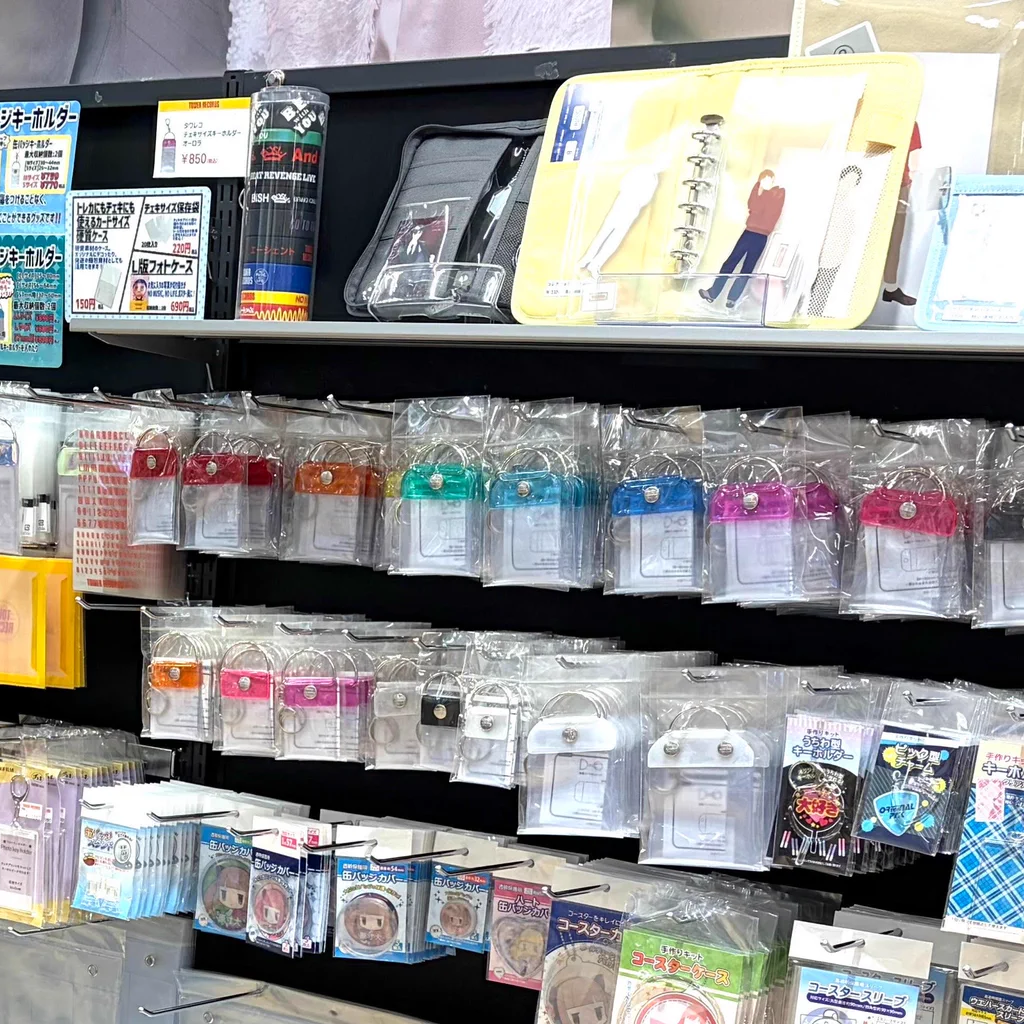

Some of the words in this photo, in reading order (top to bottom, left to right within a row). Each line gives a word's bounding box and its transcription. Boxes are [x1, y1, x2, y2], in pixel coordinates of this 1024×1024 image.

[182, 139, 202, 147] オーロラ
[182, 153, 206, 165] ¥850
[264, 172, 301, 182] REVENGE
[76, 215, 130, 228] 使えるカードサイズ
[172, 243, 192, 254] 220円
[132, 259, 193, 273] L版フォトケース
[76, 299, 96, 309] 150円
[171, 301, 189, 312] 690円
[803, 736, 842, 751] うちわ型
[792, 746, 854, 762] キーホルダー
[796, 797, 840, 818] 大好き
[254, 858, 298, 876] 缶バッジカバー
[342, 872, 402, 884] 缶バッジカバー
[434, 878, 484, 892] 缶バッジカバー
[516, 895, 540, 906] ハート
[660, 946, 703, 961] 手作りキット
[632, 952, 730, 986] コースターケース
[808, 982, 908, 1008] コースタースリーブ
